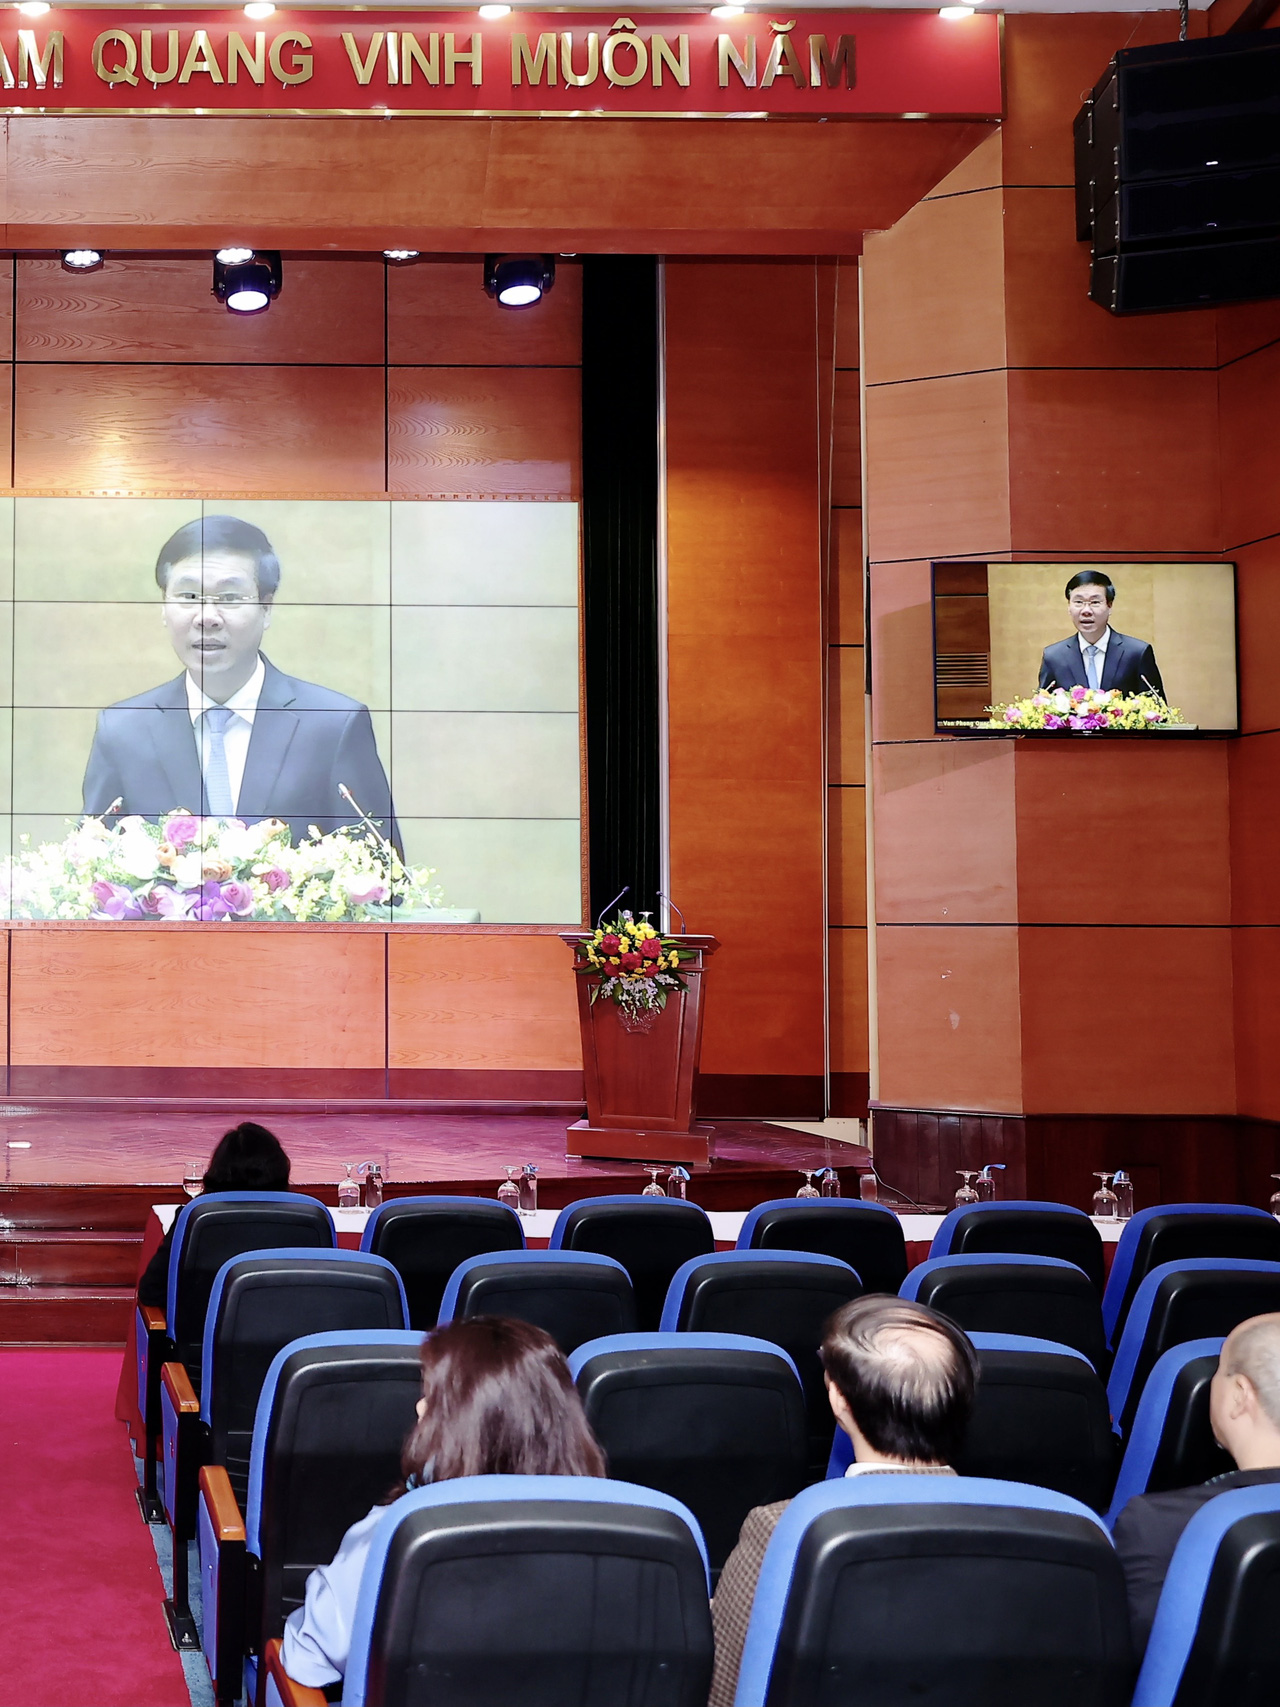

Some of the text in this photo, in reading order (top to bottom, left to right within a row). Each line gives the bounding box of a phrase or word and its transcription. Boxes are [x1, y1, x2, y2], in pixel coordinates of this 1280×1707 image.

[91, 29, 314, 87] QUANG
[341, 32, 482, 86] VINH
[510, 17, 690, 87] MUÔN
[717, 19, 857, 88] NĂM
